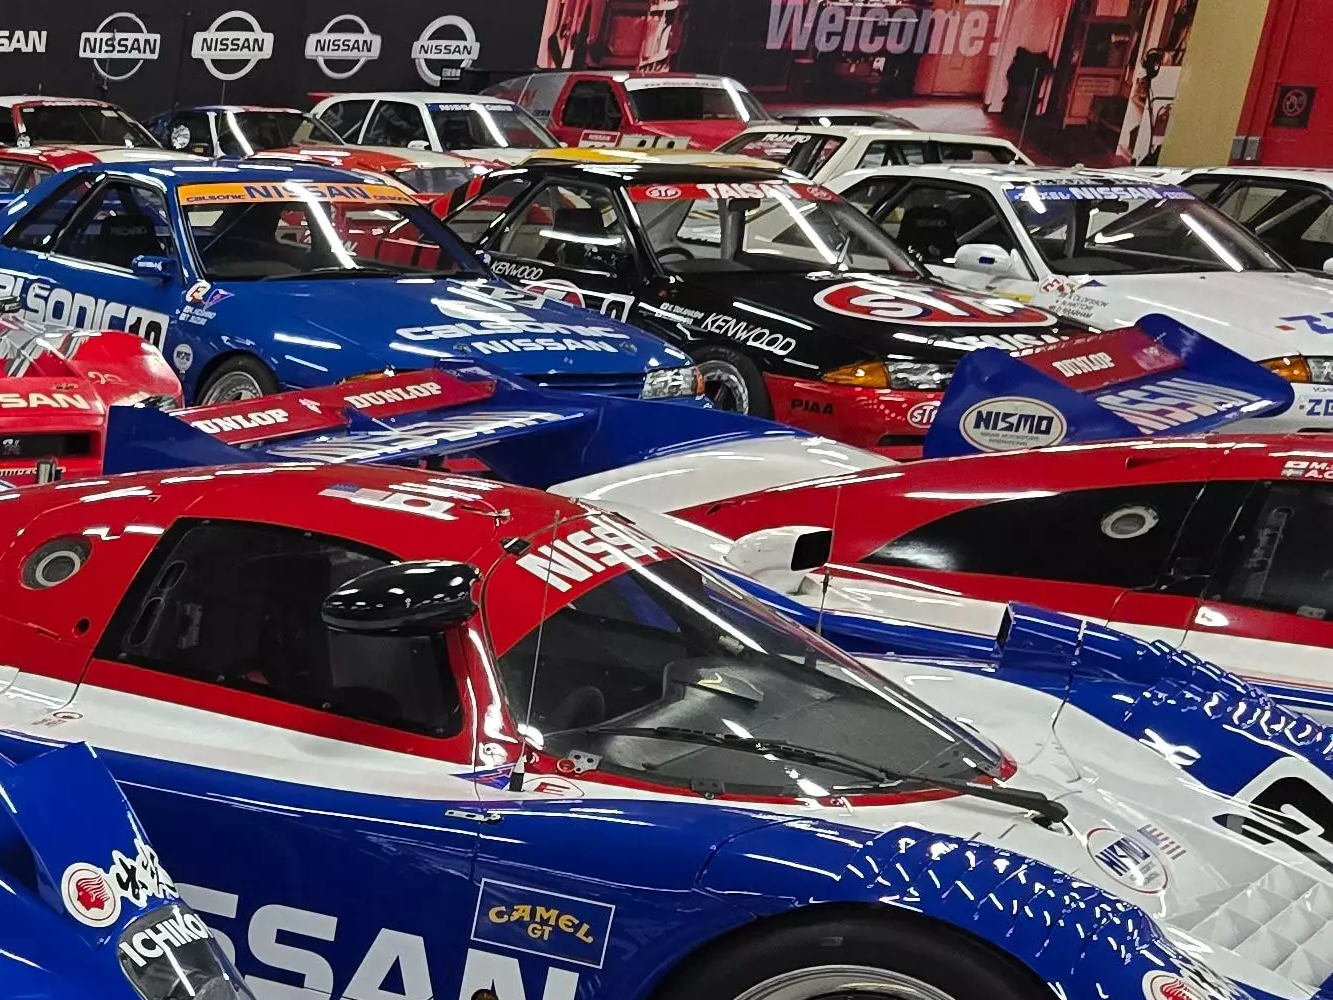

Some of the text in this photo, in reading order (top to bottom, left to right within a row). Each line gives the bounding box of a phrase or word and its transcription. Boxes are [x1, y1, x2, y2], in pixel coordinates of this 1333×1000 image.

[766, 0, 1001, 56] Welcome!
[84, 37, 159, 55] NISSAN
[201, 37, 264, 52] NISSAN
[314, 38, 373, 53] NISSAN
[419, 44, 472, 56] NISSAN
[246, 185, 368, 200] NISSAN
[697, 183, 803, 201] TAISAN
[1071, 185, 1164, 202] NISSAN
[490, 261, 543, 281] KENWOOD
[699, 312, 797, 358] KENWOOD
[471, 339, 619, 355] NISSAN
[1053, 352, 1113, 379] DUNLOP
[344, 382, 442, 409] DUNLOP
[790, 400, 833, 414] PIAA
[973, 410, 1055, 436] NISMO
[488, 904, 595, 944] CAMEL
[527, 924, 553, 942] GT
